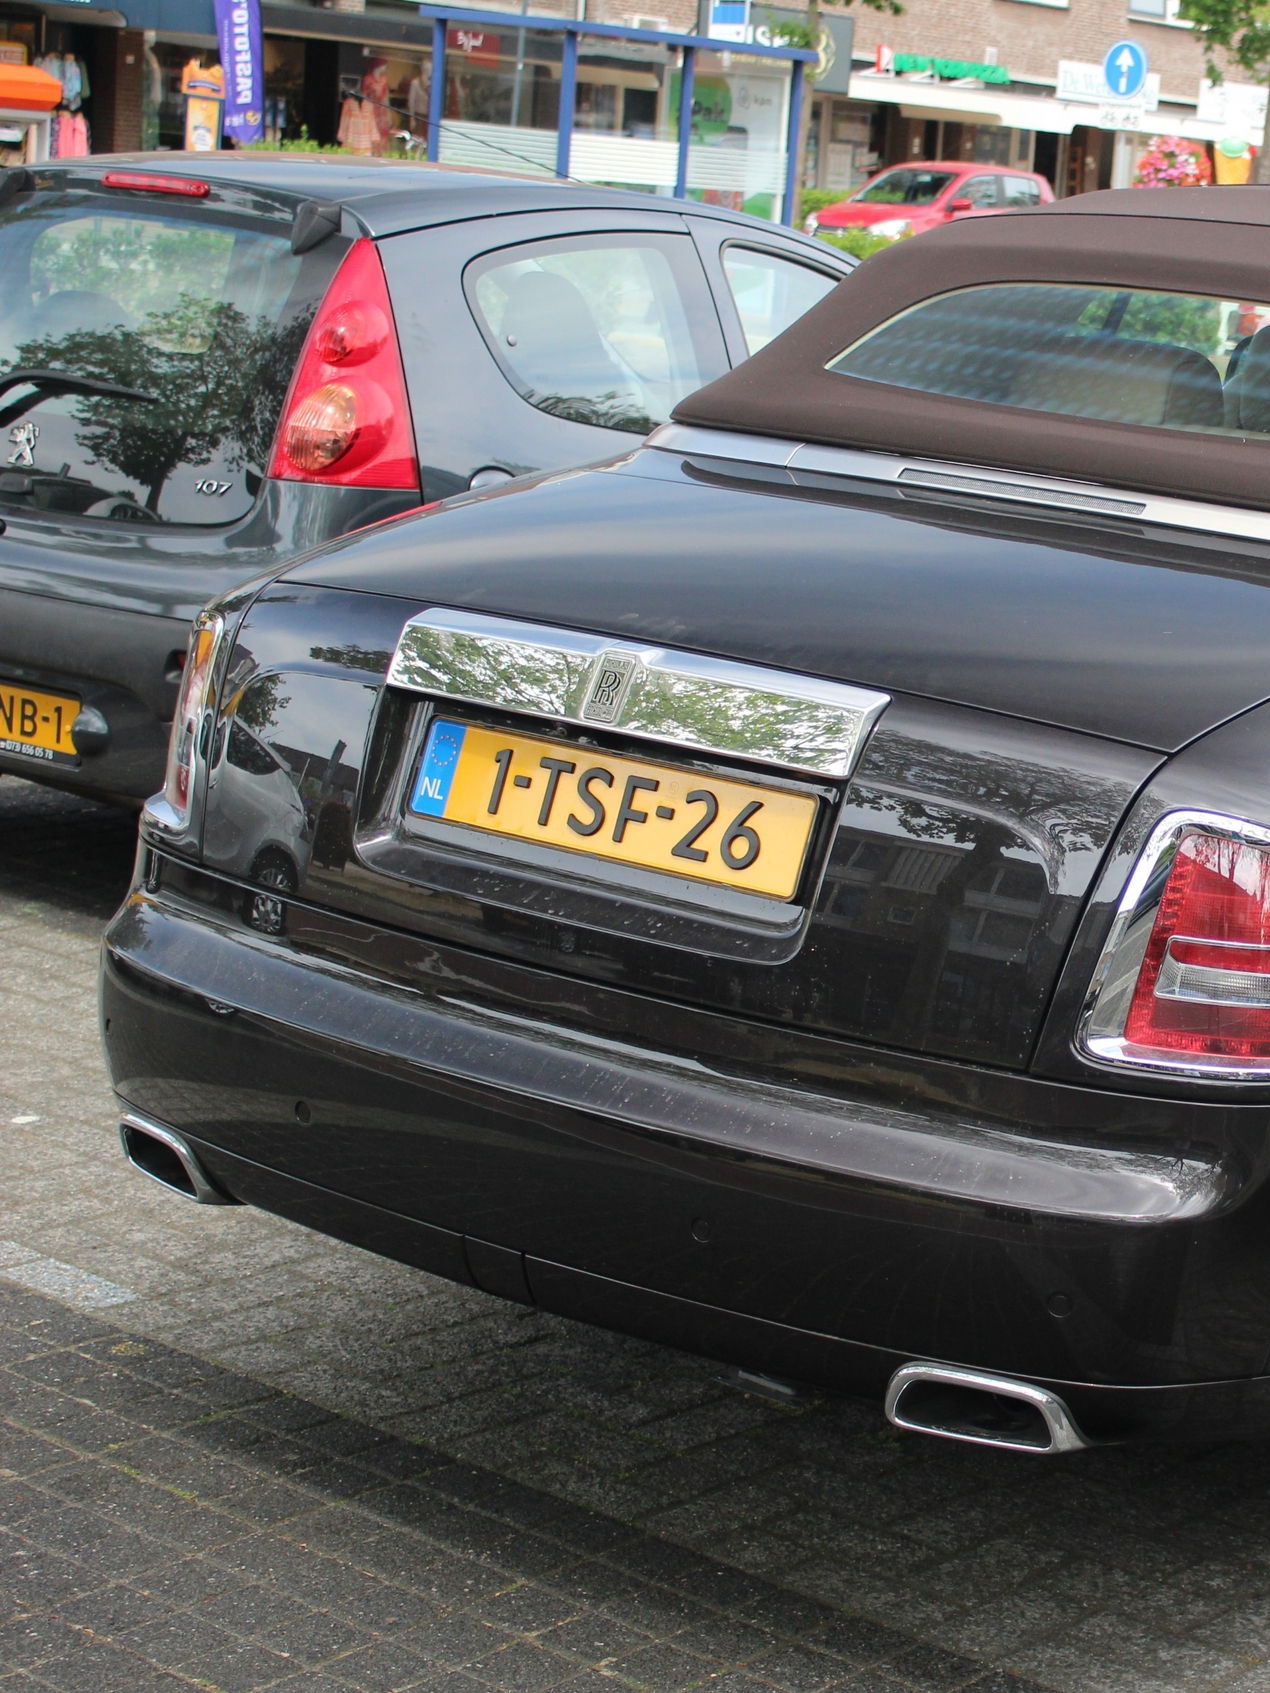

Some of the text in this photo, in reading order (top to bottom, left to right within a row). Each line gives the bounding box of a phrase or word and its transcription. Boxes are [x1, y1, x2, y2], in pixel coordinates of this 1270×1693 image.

[195, 478, 232, 496] 107
[21, 744, 35, 756] 656
[35, 747, 44, 758] 05
[44, 749, 54, 760] 78
[421, 775, 445, 801] NL
[487, 749, 763, 870] 1-TSF-26
